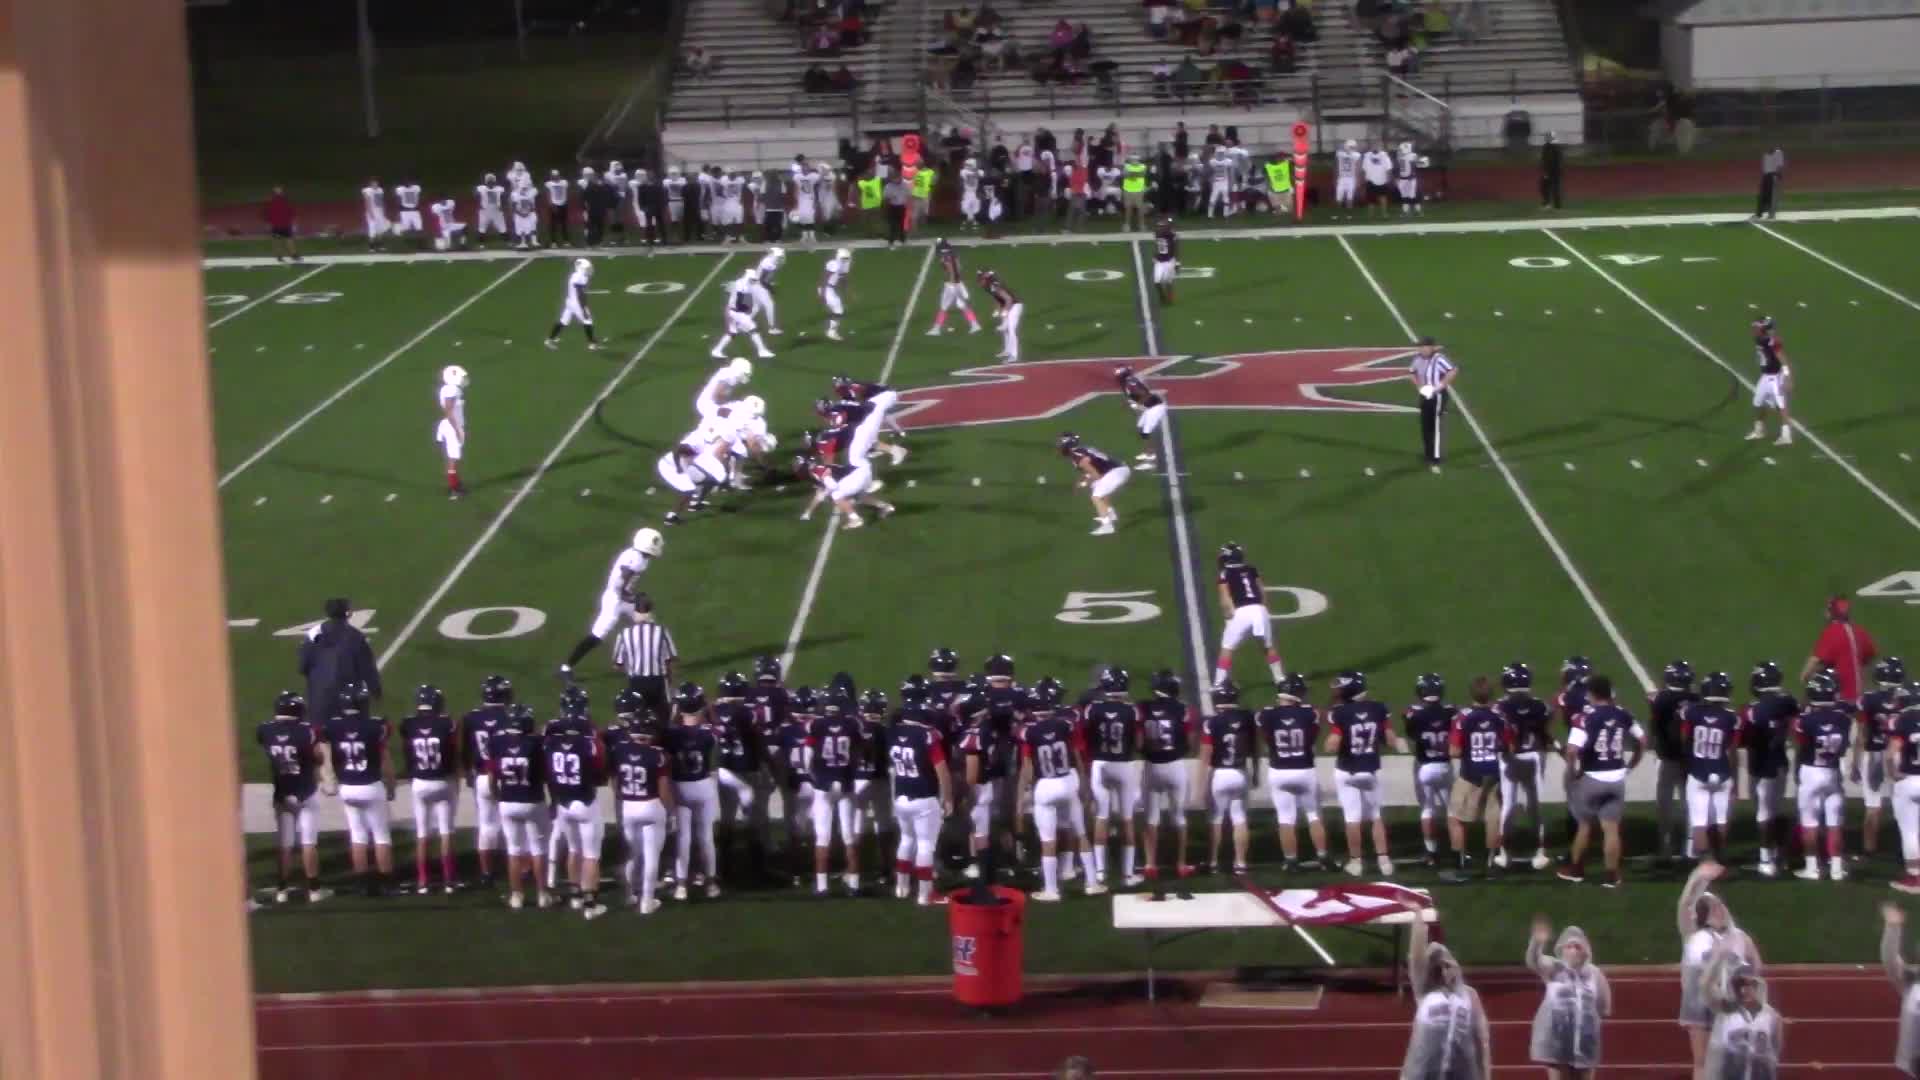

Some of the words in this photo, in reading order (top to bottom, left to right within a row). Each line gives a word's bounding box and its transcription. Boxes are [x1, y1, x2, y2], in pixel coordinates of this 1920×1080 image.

[1242, 577, 1256, 598] 1
[1222, 733, 1237, 766] 3
[1594, 727, 1625, 761] 44
